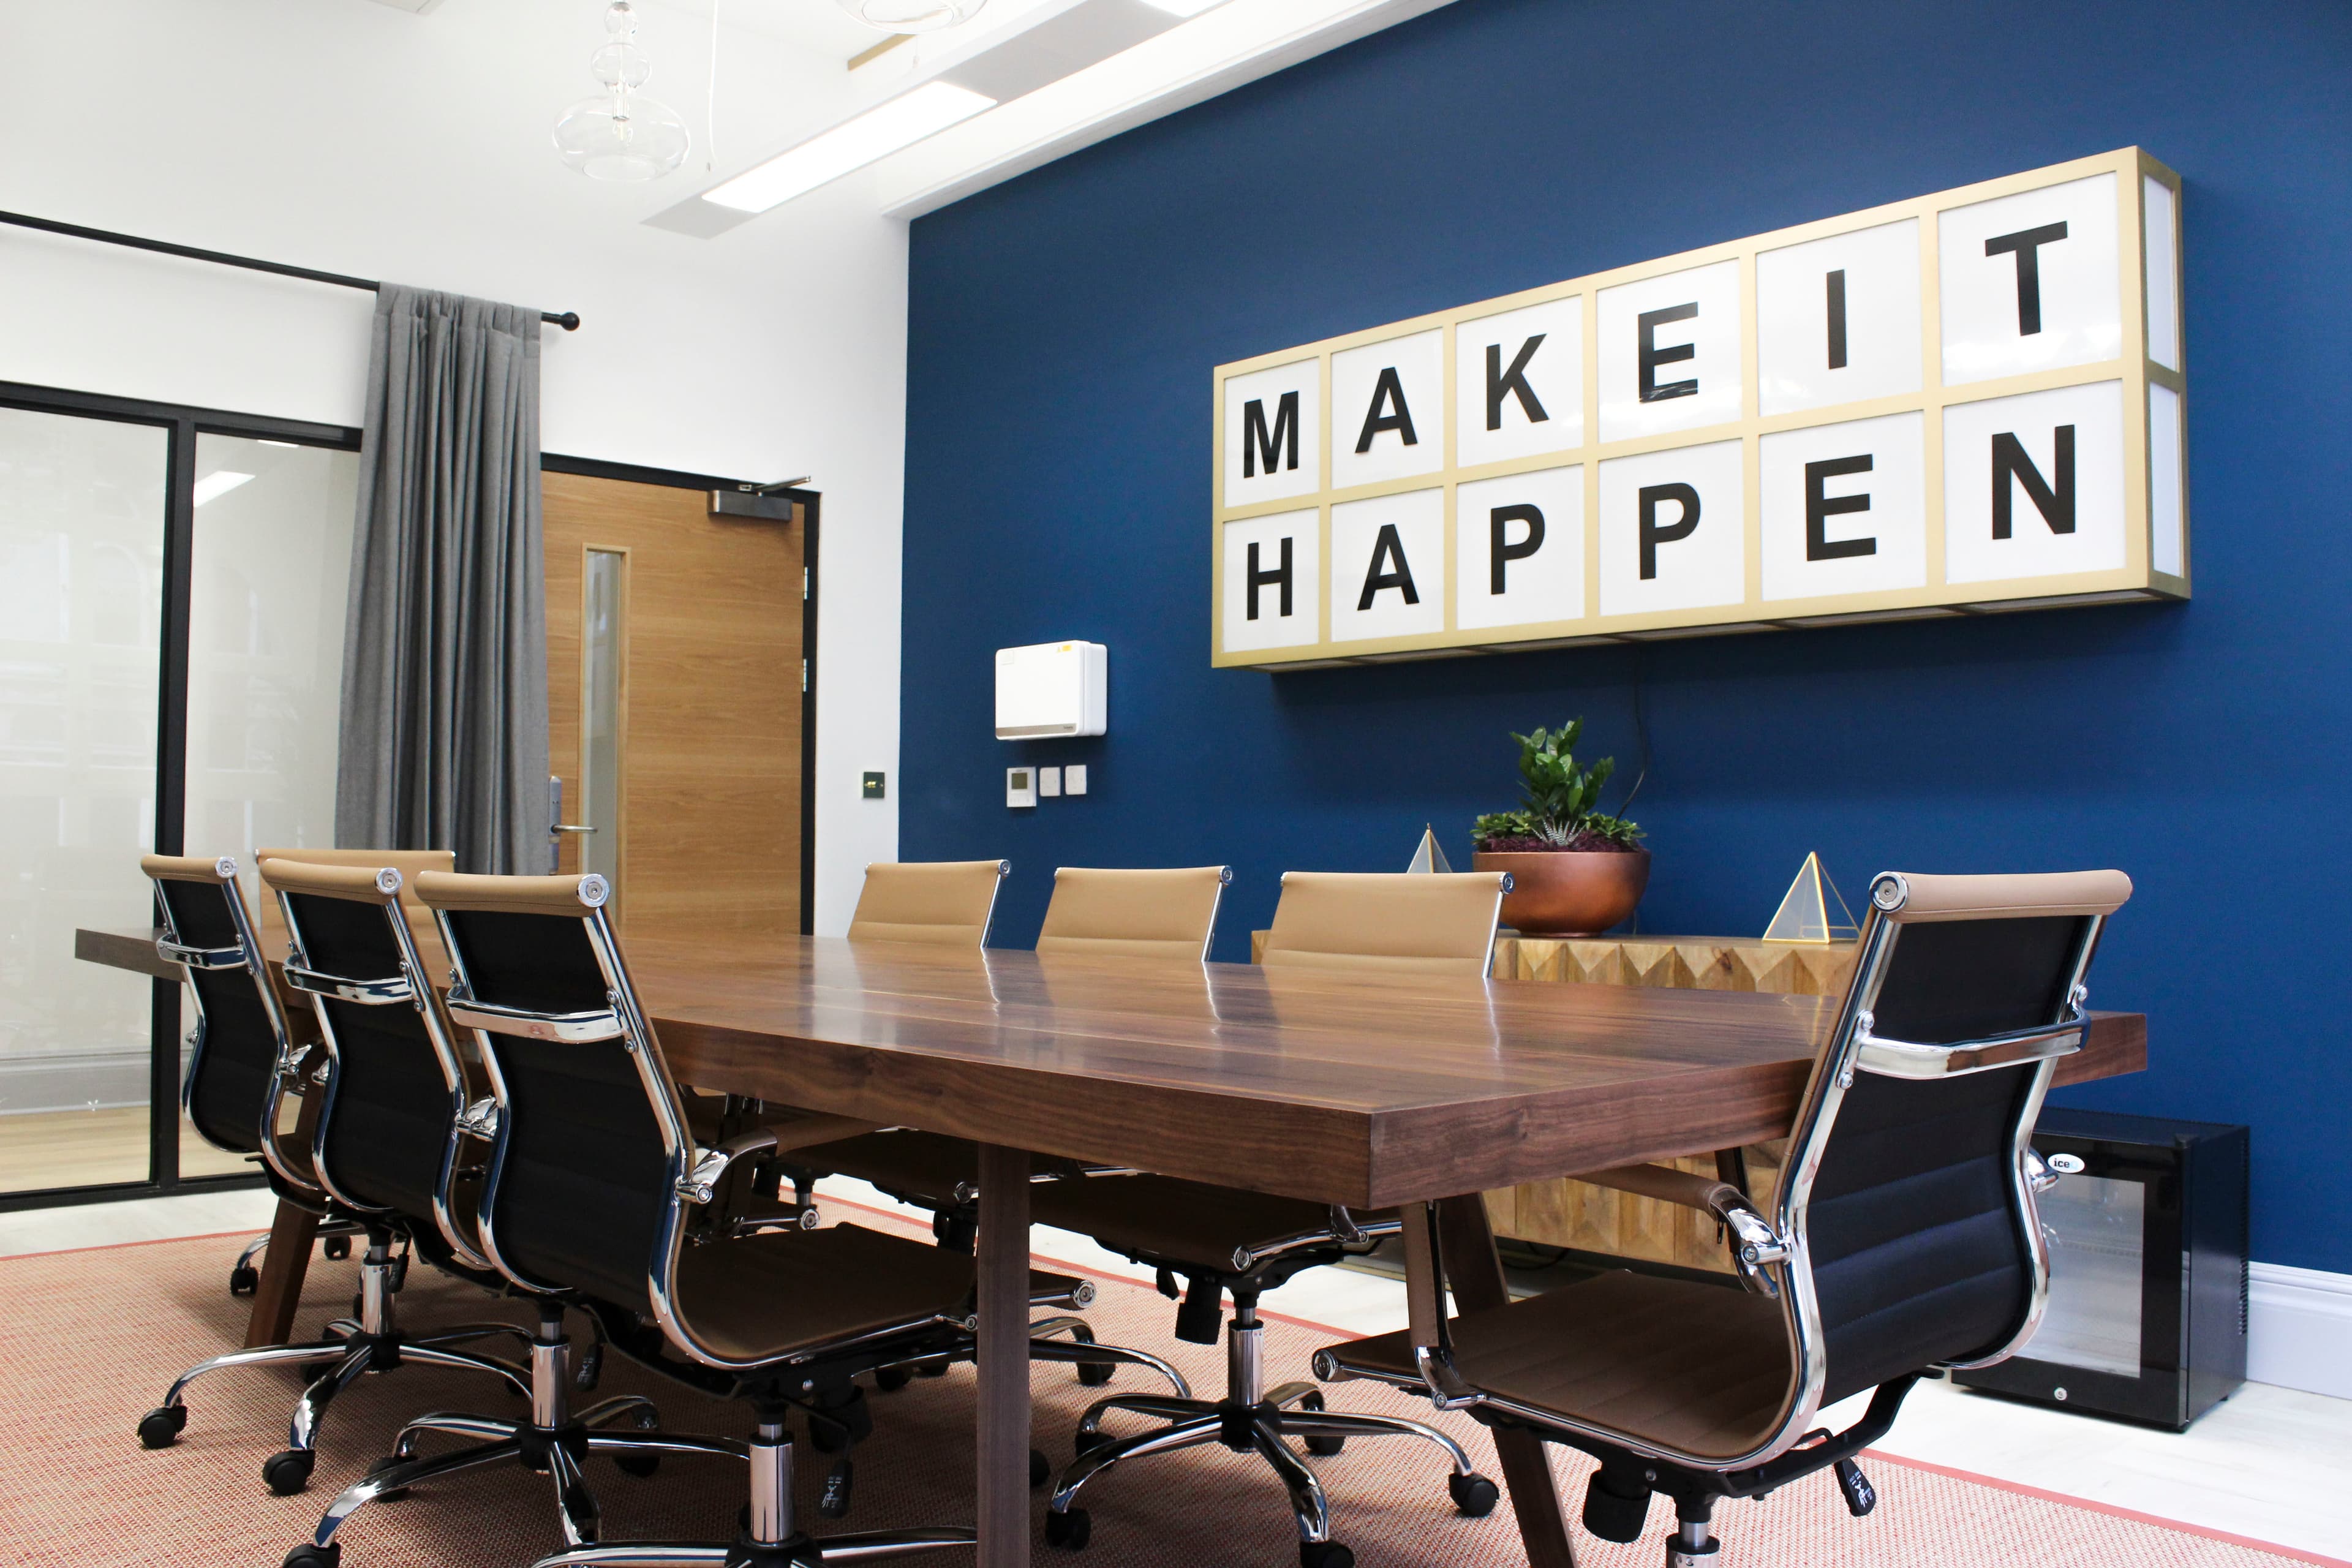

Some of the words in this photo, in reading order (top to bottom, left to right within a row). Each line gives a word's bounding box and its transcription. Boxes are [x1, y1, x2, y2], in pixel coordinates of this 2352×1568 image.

[1243, 309, 1698, 479] MAKE
[1826, 221, 2068, 370] IT
[1246, 424, 2076, 621] HAPPEN
